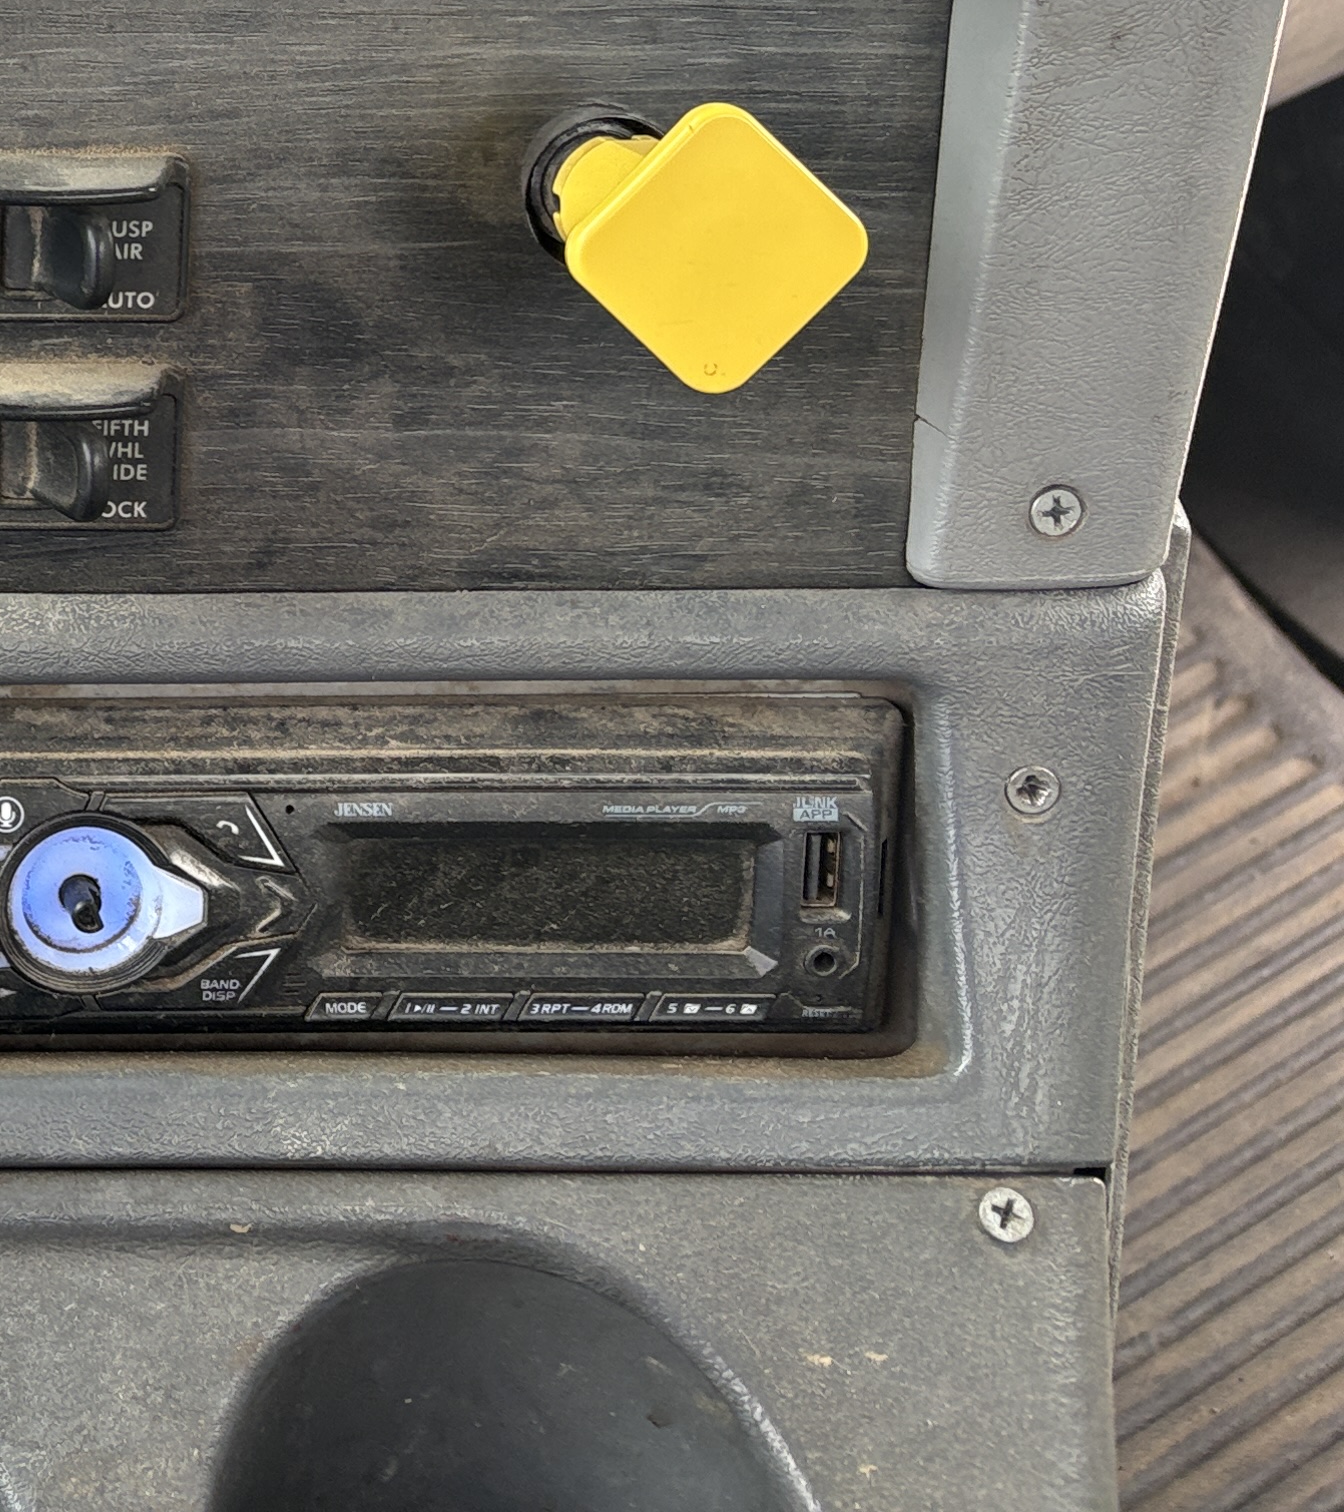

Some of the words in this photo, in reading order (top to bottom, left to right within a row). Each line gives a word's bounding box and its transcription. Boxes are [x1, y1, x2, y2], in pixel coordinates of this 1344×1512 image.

[333, 802, 393, 818] JENSEN
[602, 805, 645, 814] MEDIA
[646, 805, 697, 814] PLAYER
[717, 804, 749, 815] MP3
[799, 809, 833, 819] APP
[814, 927, 836, 938] 1A
[200, 978, 241, 991] BAND
[201, 990, 237, 1002] DISP
[325, 1002, 367, 1014] MODE
[460, 1003, 471, 1014] 2
[474, 1003, 501, 1015] INT
[666, 1002, 679, 1014] 5
[725, 1002, 737, 1014] 6
